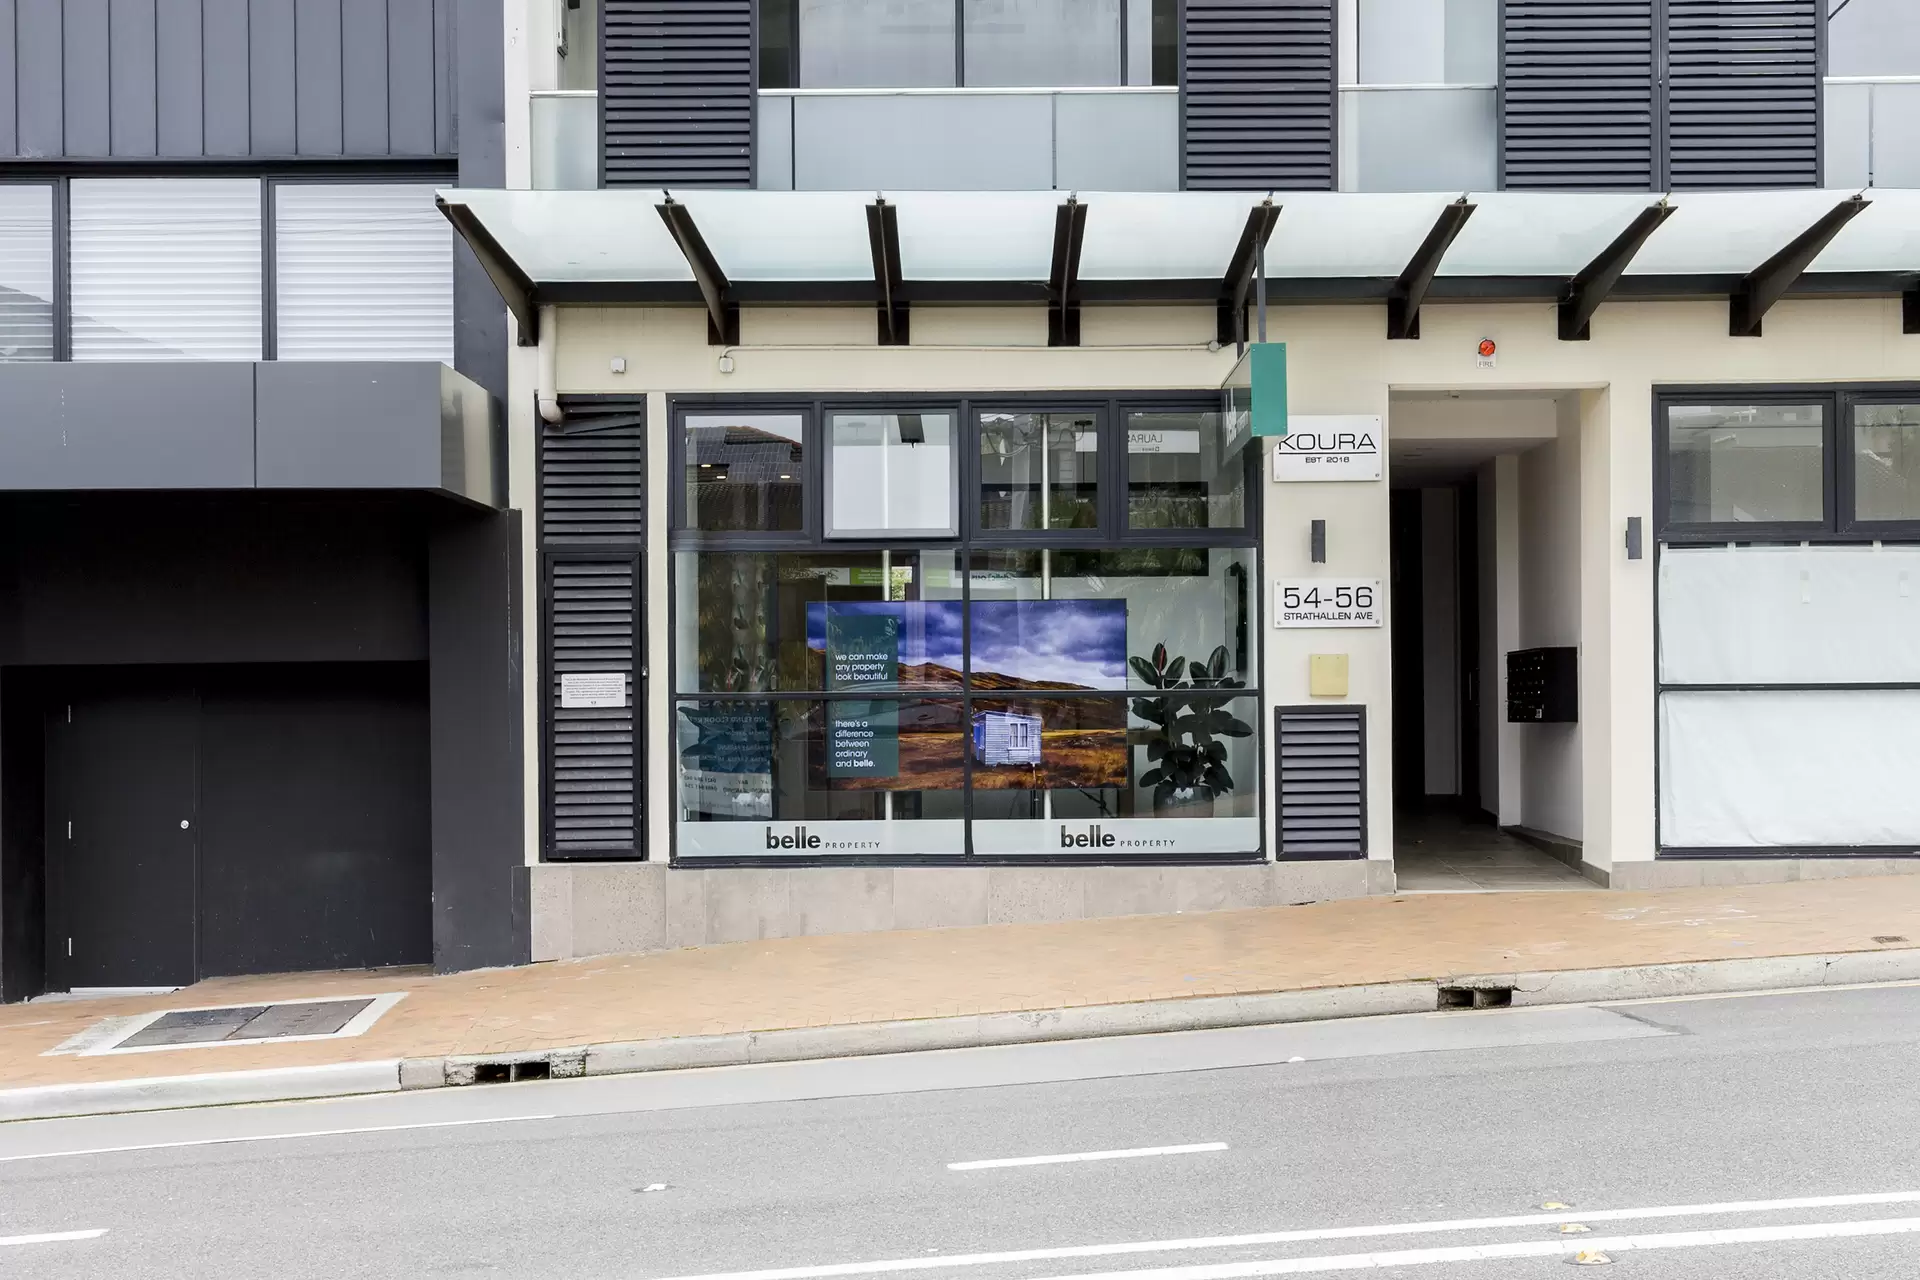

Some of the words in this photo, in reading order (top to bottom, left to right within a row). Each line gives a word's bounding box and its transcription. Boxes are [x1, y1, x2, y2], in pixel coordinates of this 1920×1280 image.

[1279, 433, 1377, 451] KOURA
[1305, 456, 1322, 464] EST
[1283, 586, 1373, 609] 54-56
[1283, 611, 1352, 621] STRATHALLEN
[1354, 611, 1373, 620] AVE
[866, 652, 889, 661] make
[835, 663, 850, 671] any
[852, 662, 885, 672] property
[835, 672, 852, 681] look
[853, 672, 888, 681] beautiful
[835, 719, 861, 728] there's
[835, 730, 874, 738] difference
[835, 739, 870, 748] between
[835, 750, 868, 758] ordinary
[835, 759, 852, 768] and
[853, 759, 876, 768] belle.
[766, 826, 821, 850] belle
[825, 841, 881, 849] PROPERTY
[1060, 825, 1115, 848] belle
[1120, 839, 1176, 847] PROPERTY
